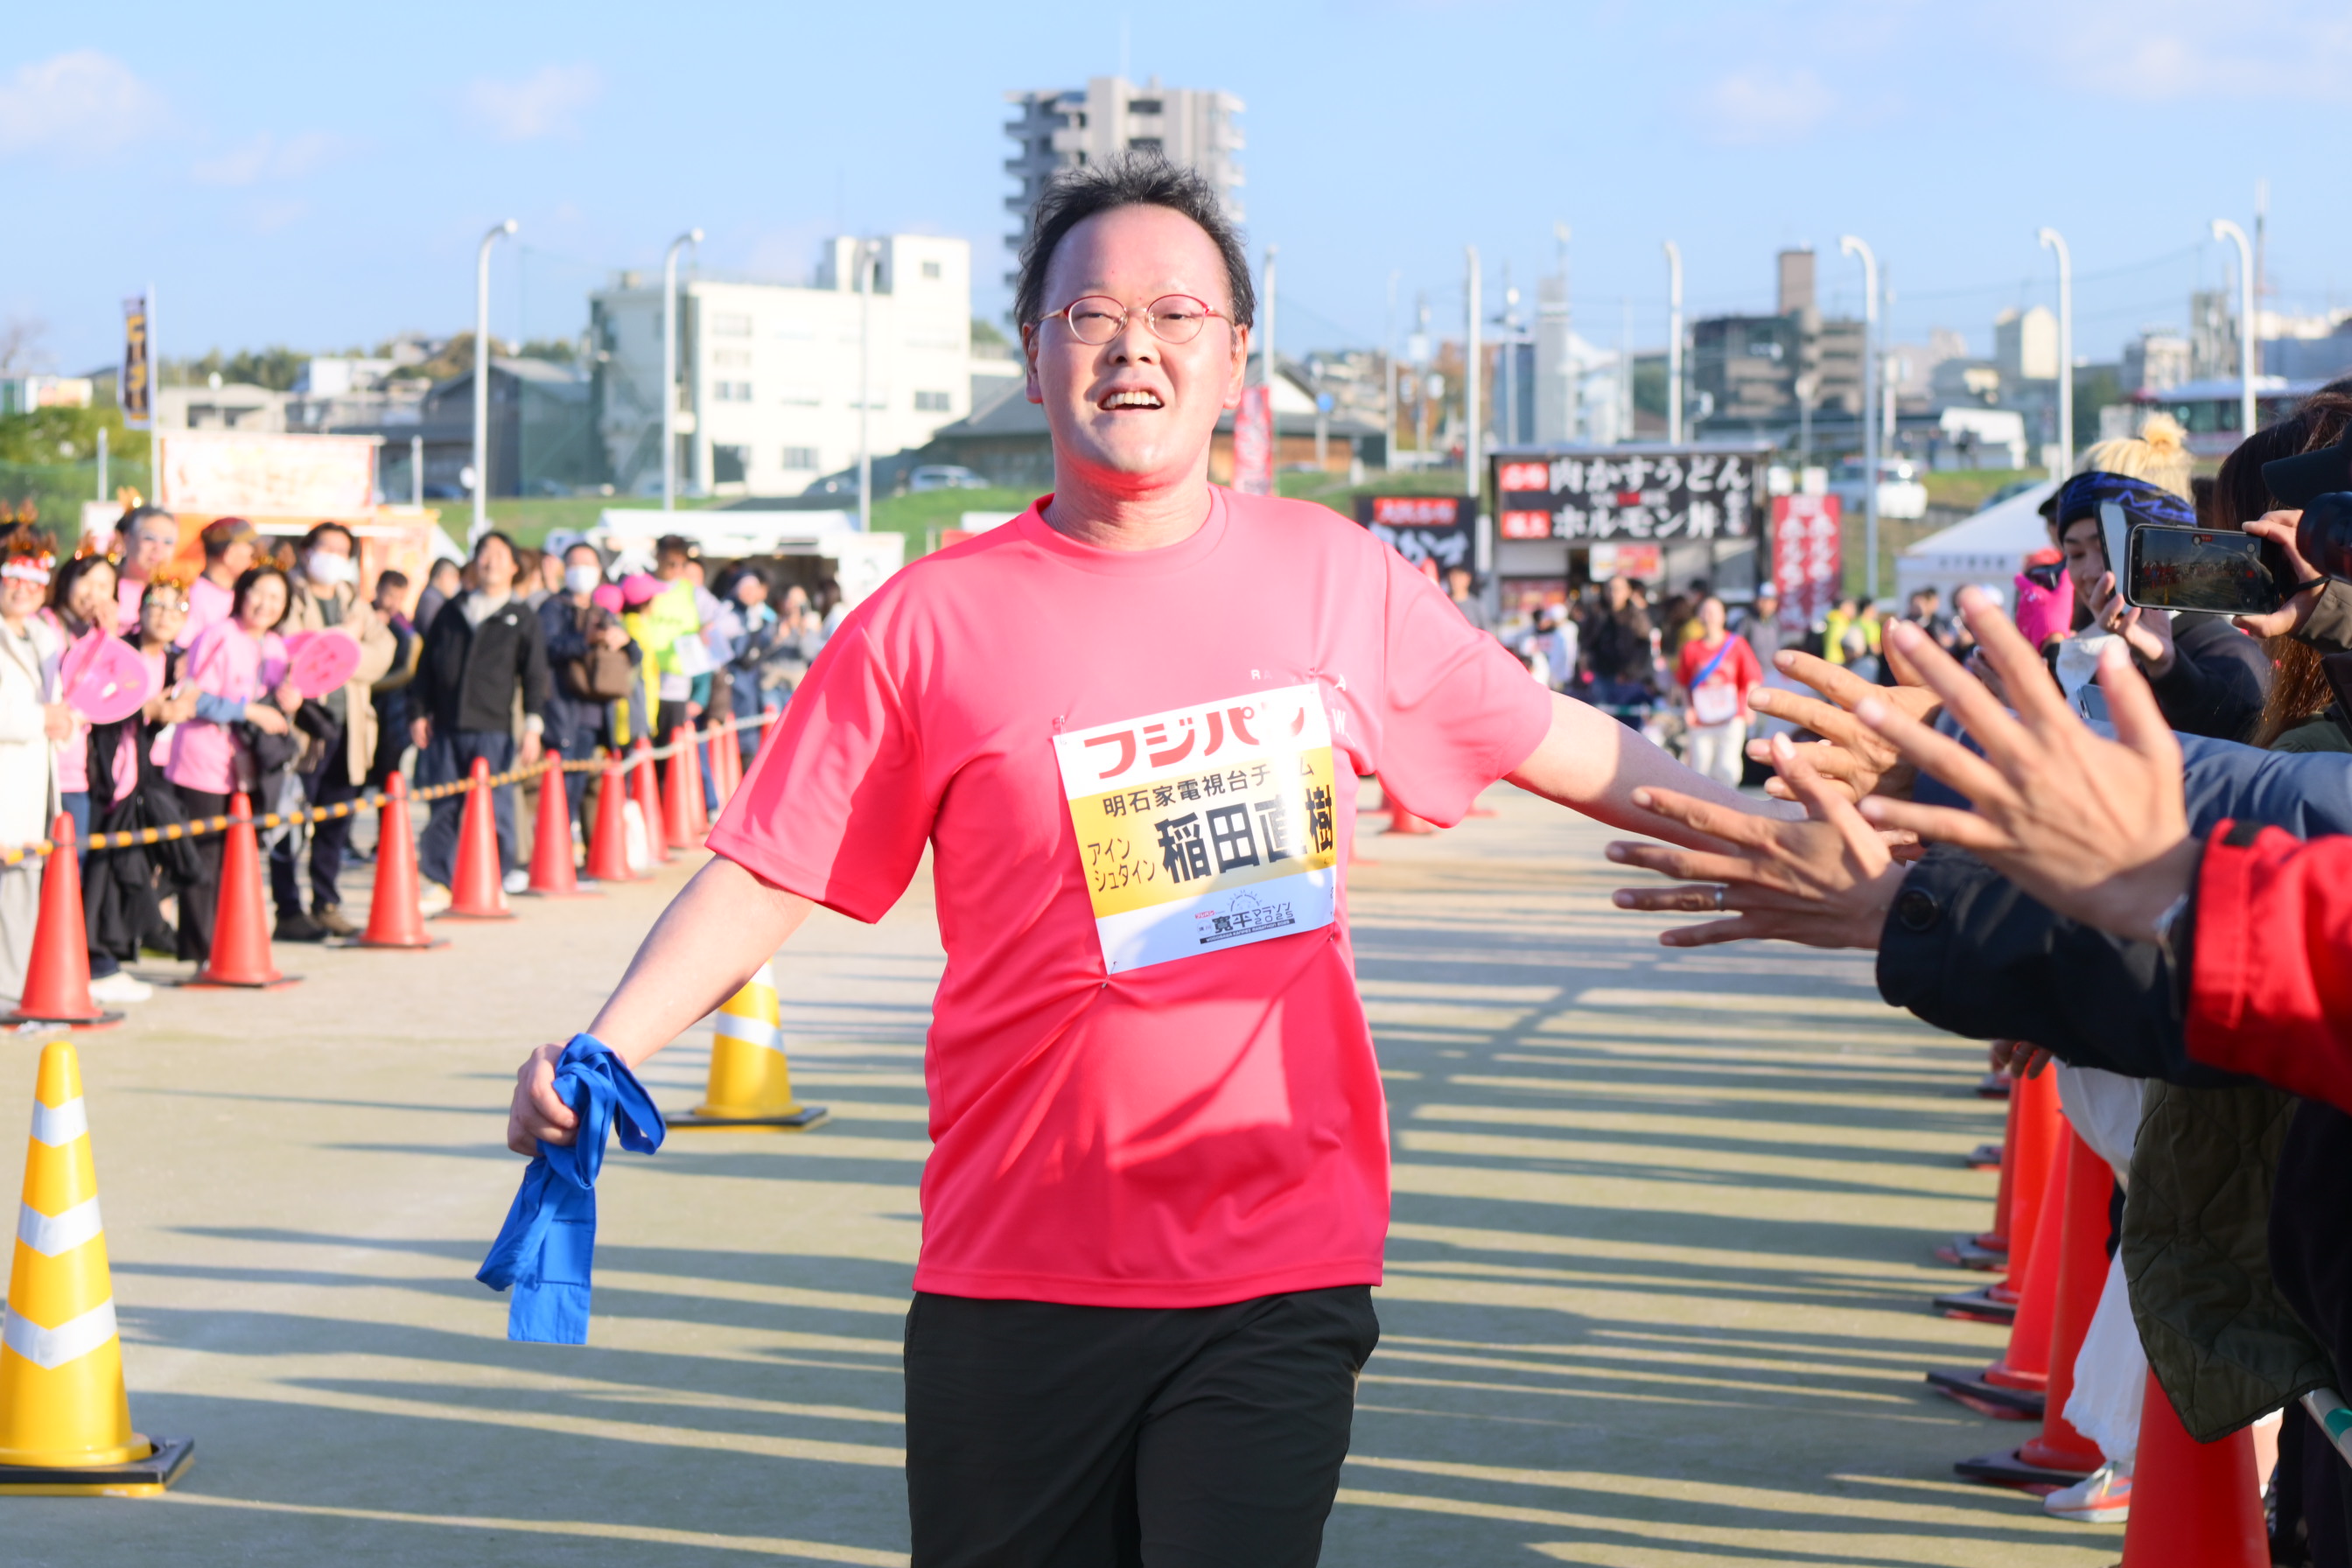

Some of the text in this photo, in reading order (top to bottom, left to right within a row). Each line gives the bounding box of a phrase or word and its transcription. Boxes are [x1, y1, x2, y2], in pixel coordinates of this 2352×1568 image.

[1102, 757, 1315, 818] 明石家電視台チム
[1088, 837, 1130, 866] アイン
[1154, 785, 1334, 884] 稲田直樹
[1095, 859, 1155, 892] シュタイン
